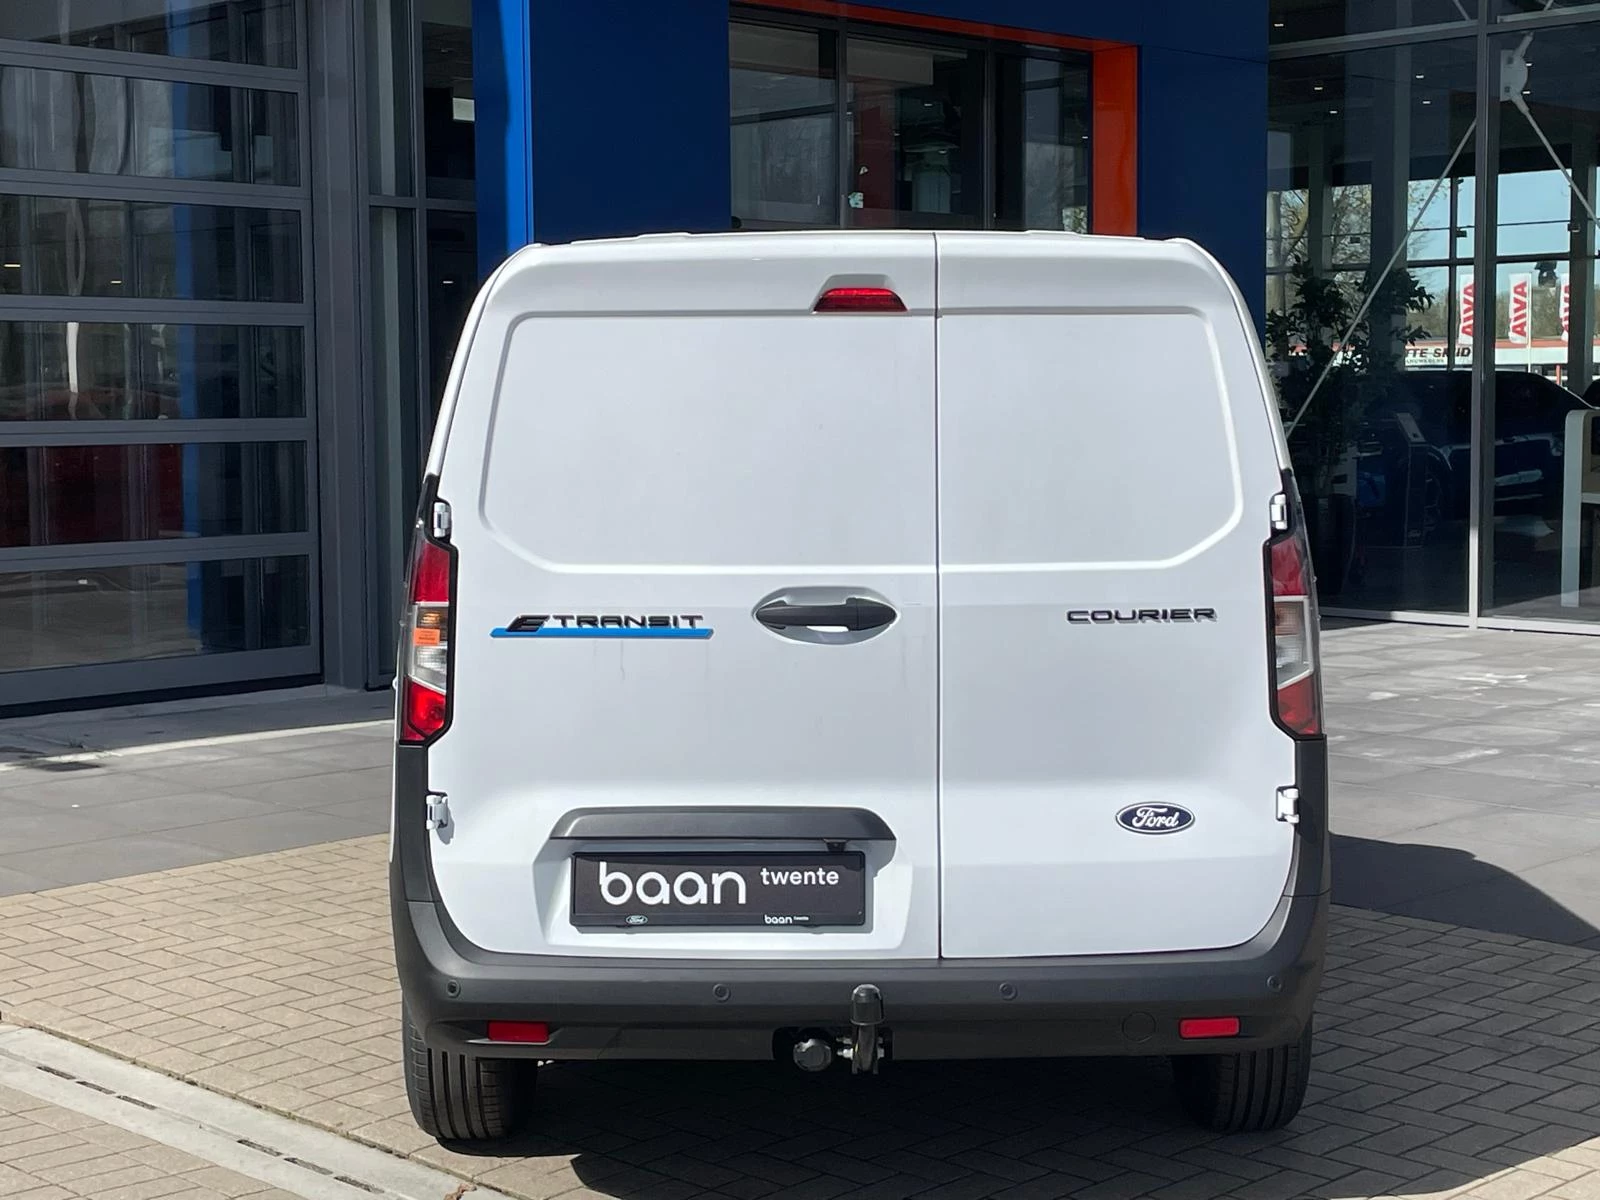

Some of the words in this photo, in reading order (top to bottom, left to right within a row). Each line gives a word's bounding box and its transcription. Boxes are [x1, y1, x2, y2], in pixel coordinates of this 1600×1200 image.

[1067, 607, 1217, 624] COURIER
[1131, 806, 1180, 828] Ford
[599, 861, 747, 906] baan
[760, 867, 840, 886] twente
[764, 914, 793, 924] baan
